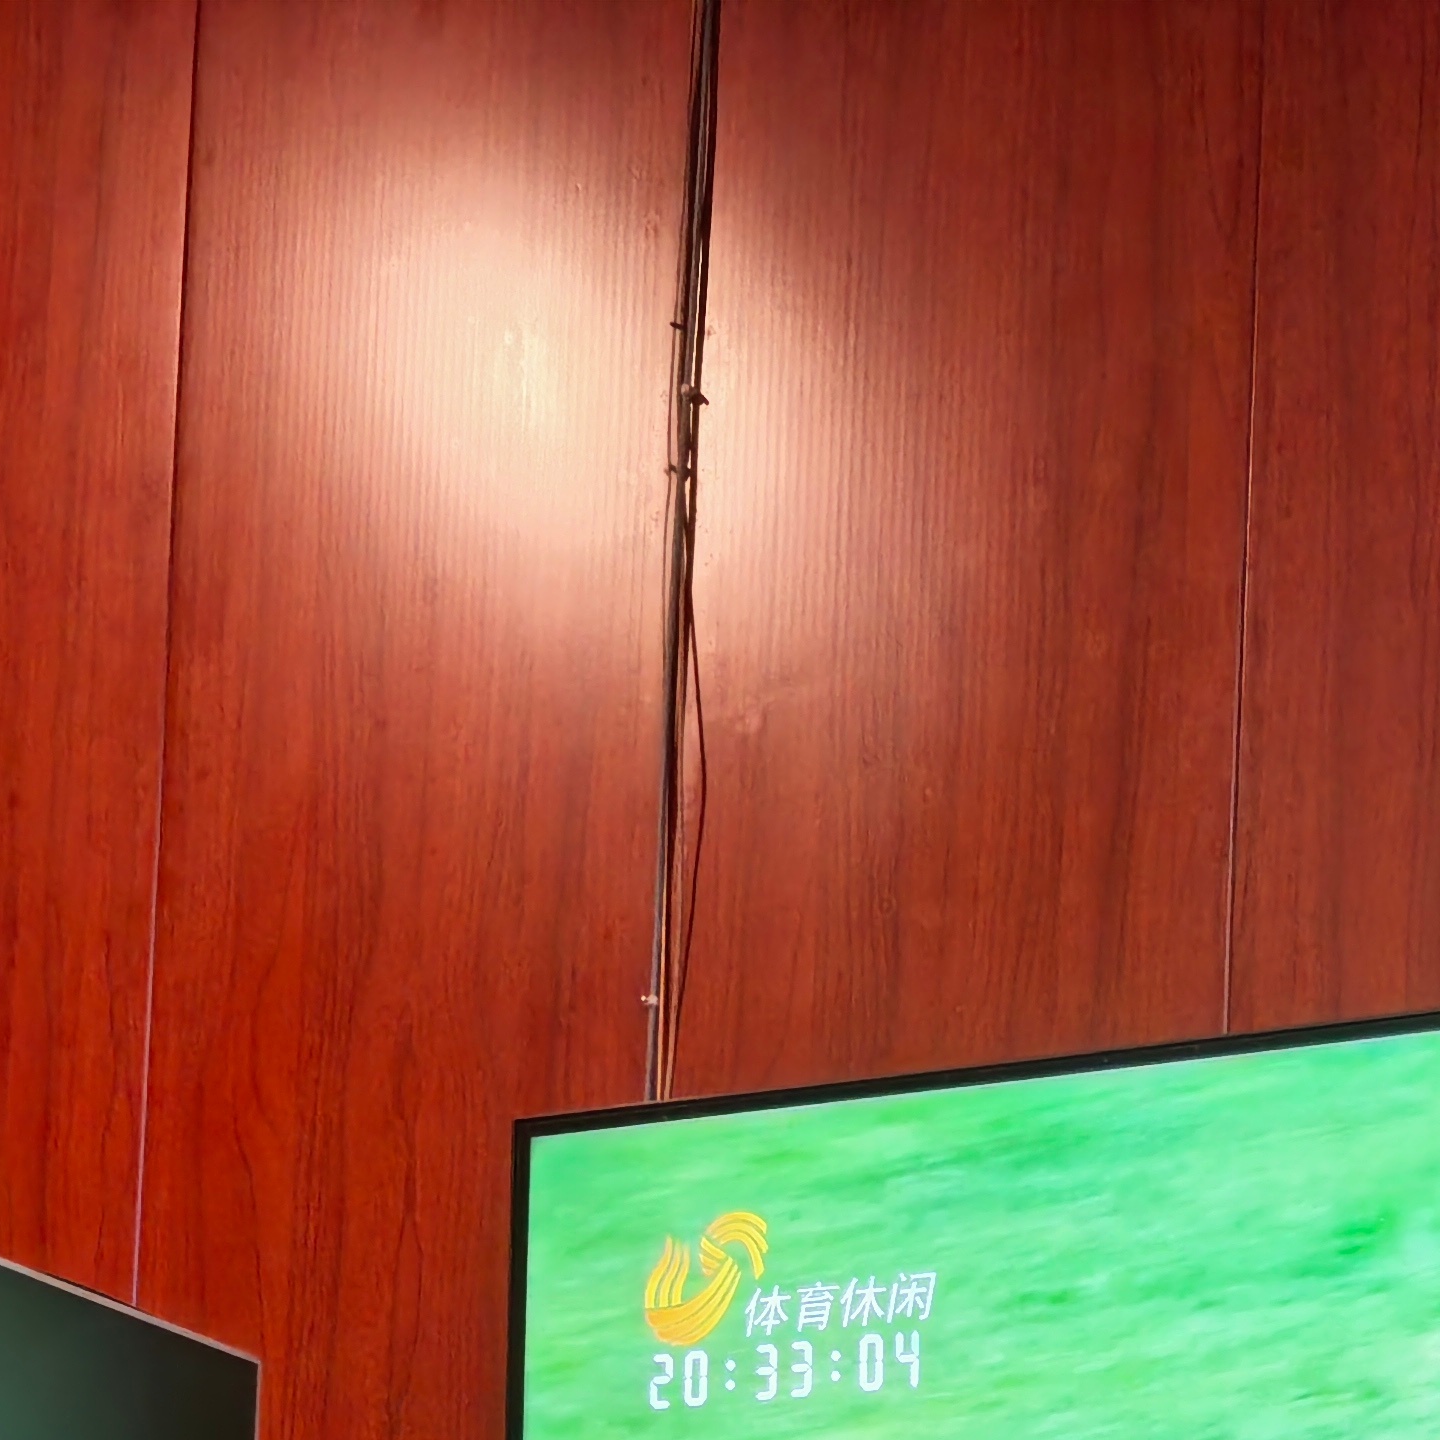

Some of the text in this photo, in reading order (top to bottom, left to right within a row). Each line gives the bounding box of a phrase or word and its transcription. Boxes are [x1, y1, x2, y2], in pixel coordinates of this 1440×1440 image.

[743, 1271, 938, 1338] 体育休闲
[648, 1330, 920, 1410] 20:33:04
